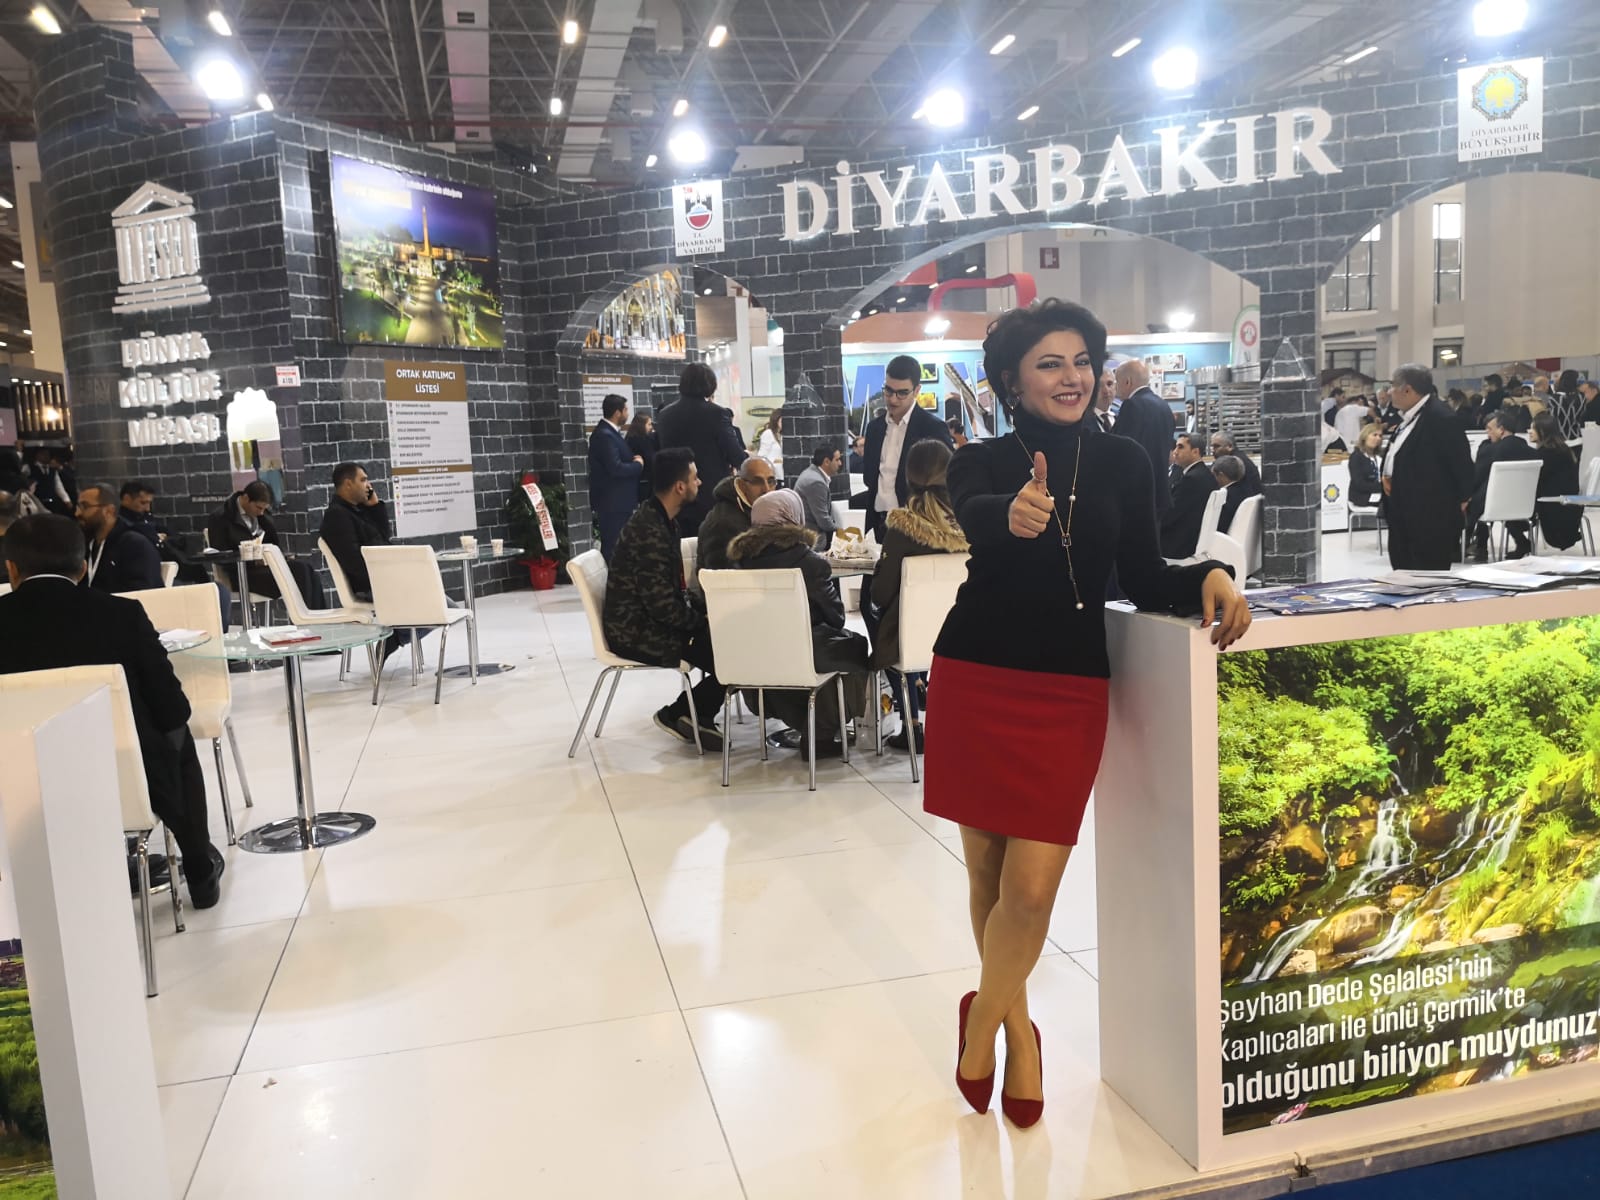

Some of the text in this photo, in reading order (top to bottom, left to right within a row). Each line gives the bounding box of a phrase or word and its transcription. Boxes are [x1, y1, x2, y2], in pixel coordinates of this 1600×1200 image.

[777, 106, 1343, 241] DİYARBAKIR
[121, 331, 211, 368] DÜNYA
[396, 368, 456, 380] ORTAK KATILIMCI
[415, 382, 440, 394] LİSTESİ
[1308, 976, 1364, 1009] Dede
[1341, 1013, 1367, 1041] ile
[1372, 1003, 1419, 1035] ünlü
[1222, 1008, 1600, 1109] olduğunu biliyor muydunuz
